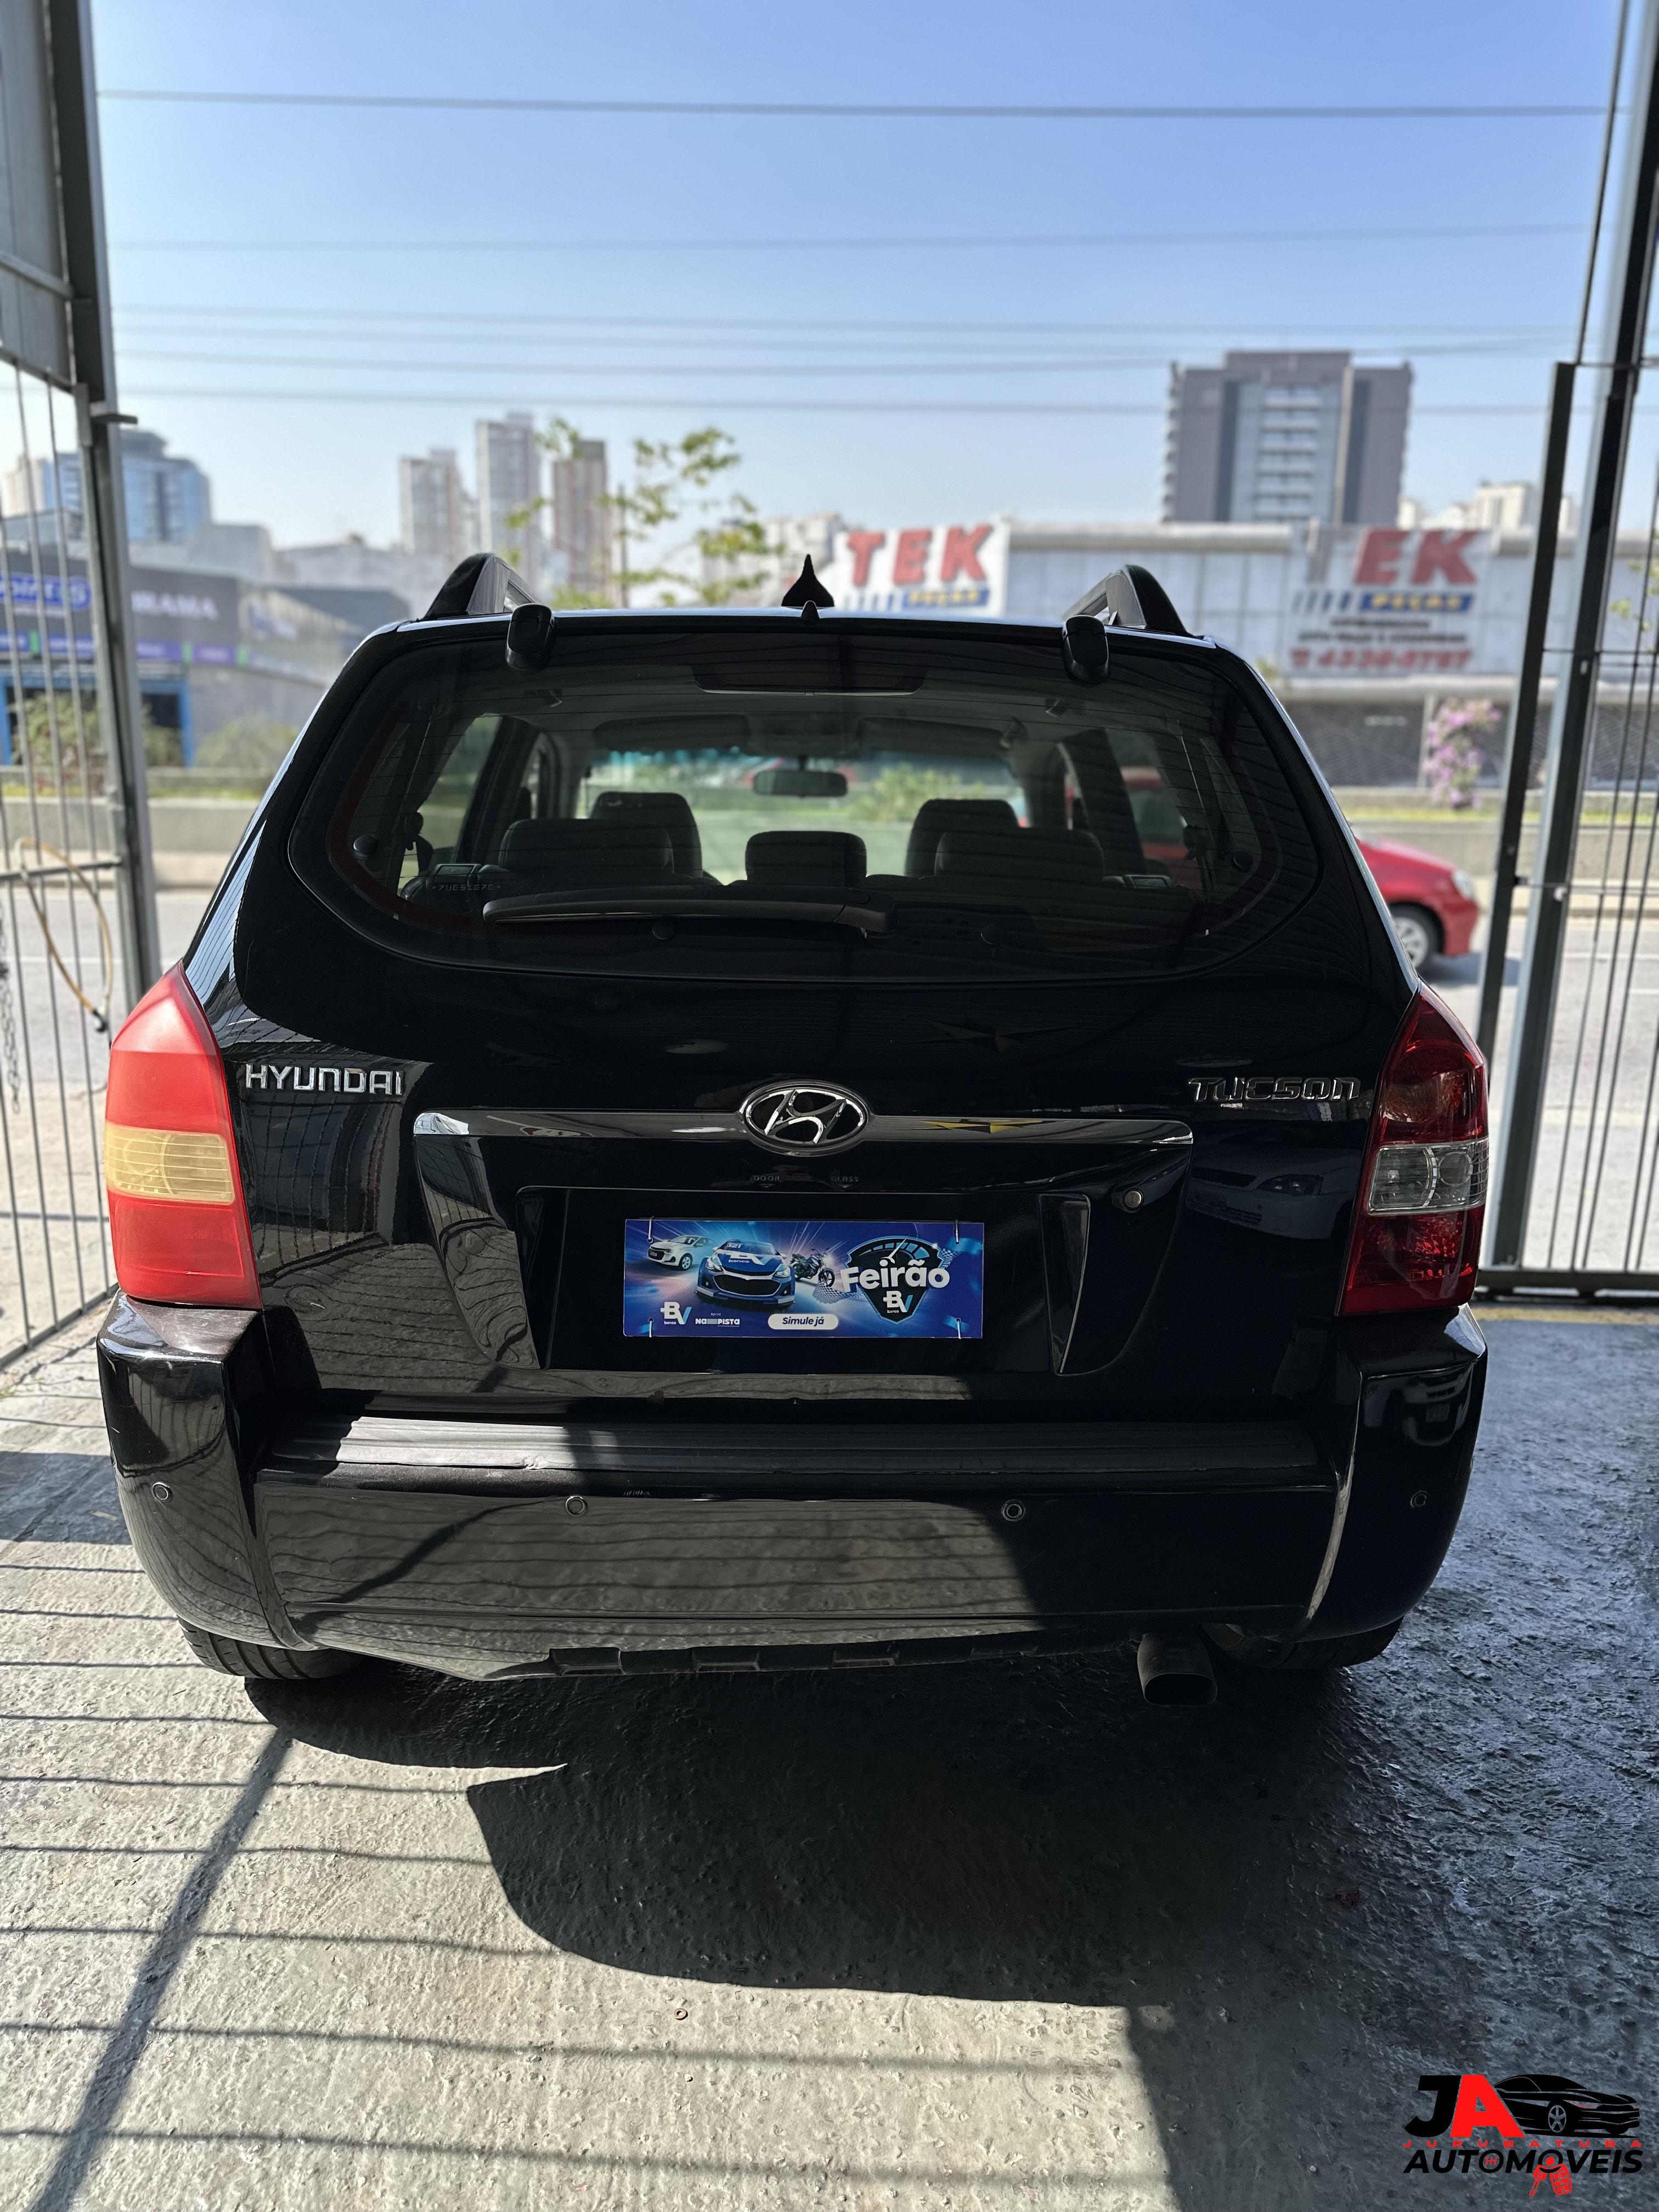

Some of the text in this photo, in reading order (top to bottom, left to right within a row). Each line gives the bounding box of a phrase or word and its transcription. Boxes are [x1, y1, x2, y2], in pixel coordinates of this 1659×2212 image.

[847, 524, 994, 587] TEK
[246, 1063, 404, 1096] HYUNDAI
[1188, 1076, 1362, 1102] TUCSON
[840, 1259, 950, 1293] Feirão
[660, 1301, 692, 1325] BV
[883, 1290, 913, 1313] BV
[782, 1317, 825, 1327] Simule já
